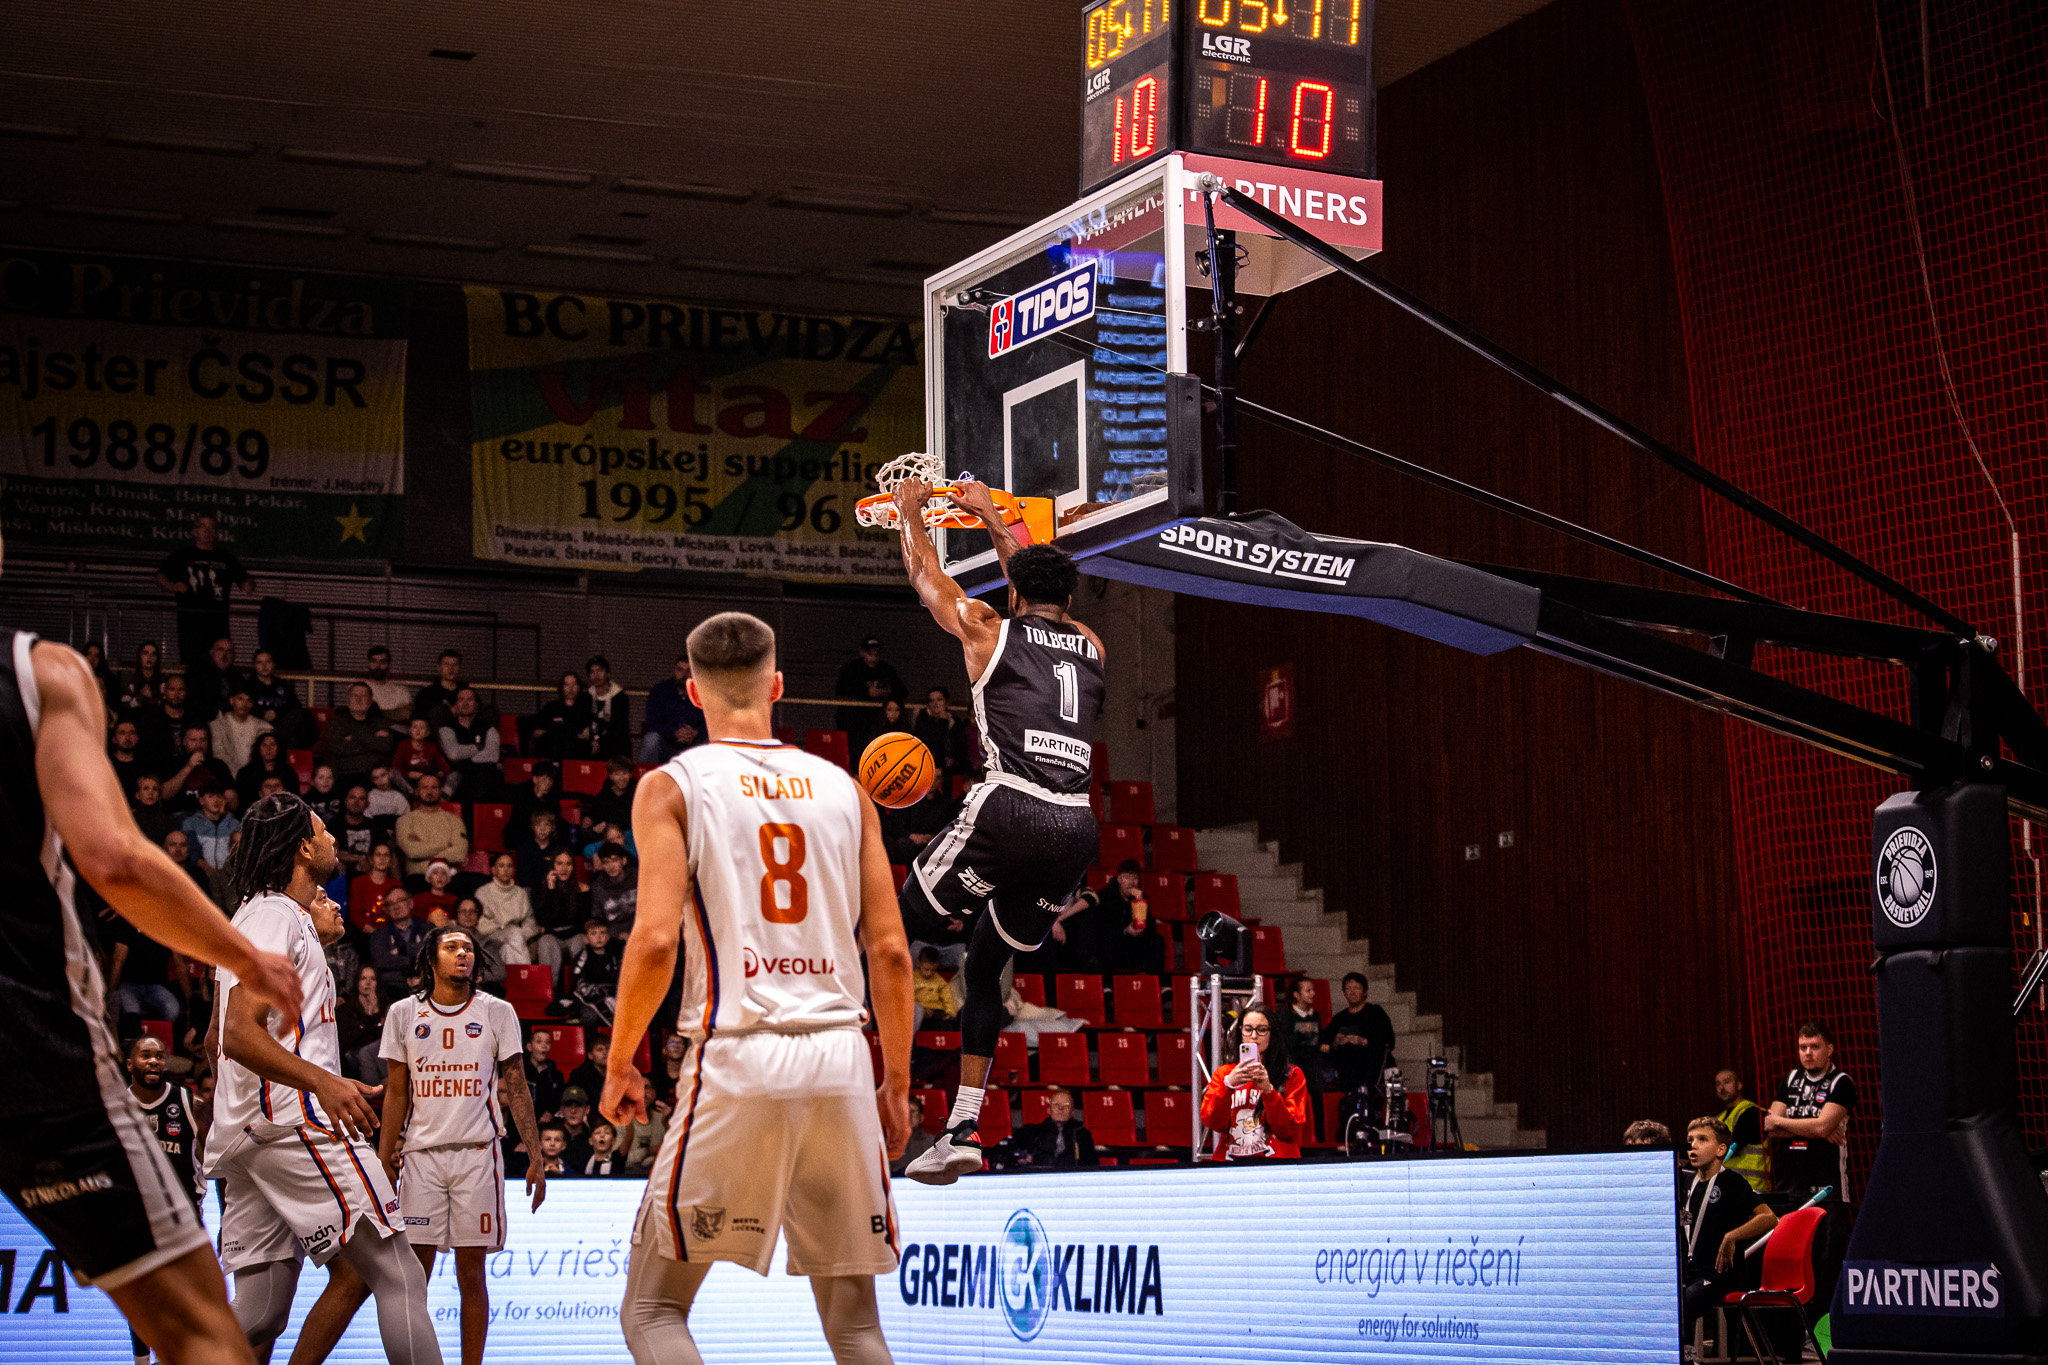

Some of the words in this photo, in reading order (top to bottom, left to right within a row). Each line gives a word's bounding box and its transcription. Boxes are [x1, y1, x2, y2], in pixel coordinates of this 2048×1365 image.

[1202, 32, 1250, 56] LGR
[1202, 50, 1250, 63] electronic
[1086, 85, 1110, 102] electronic
[1087, 67, 1110, 95] LGR
[1113, 76, 1157, 163] 10
[1254, 78, 1334, 158] 10
[1190, 176, 1368, 226] ARTNERS
[67, 262, 375, 336] Prievidza
[1018, 271, 1091, 336] TIPOS
[500, 291, 588, 341] BC
[606, 300, 918, 366] PRIEVIDZA
[189, 336, 366, 407] ČSSR
[33, 416, 268, 479] 1988/89
[501, 434, 710, 482] európskej
[725, 449, 884, 491] superlig
[577, 479, 712, 526] 1995
[779, 493, 841, 533] 96
[1160, 525, 1248, 561] SPORT
[1248, 543, 1355, 578] SYSTEM
[1023, 624, 1086, 655] TOLBERT
[1053, 660, 1078, 723] 1
[1031, 736, 1089, 761] PARTNERS
[877, 763, 917, 800] Wilson
[1885, 832, 1928, 861] PRIEVIDZA
[759, 821, 808, 924] 8
[1884, 890, 1931, 922] BASKETBALL
[443, 1028, 454, 1050] 0
[425, 1060, 479, 1072] mimel
[415, 1075, 482, 1097] LUČENEC
[481, 1213, 492, 1234] 0
[527, 1250, 548, 1277] v
[900, 1243, 996, 1309] GREMI
[1051, 1244, 1164, 1316] KLIMA
[1316, 1237, 1407, 1299] energia
[1414, 1249, 1429, 1285] v
[1435, 1235, 1525, 1287] riešení
[1848, 1267, 2000, 1309] PARTNERS
[504, 1301, 531, 1321] for
[536, 1301, 619, 1320] solutions
[1358, 1317, 1399, 1342] energy
[1400, 1313, 1420, 1338] for
[1421, 1314, 1480, 1341] solutions
